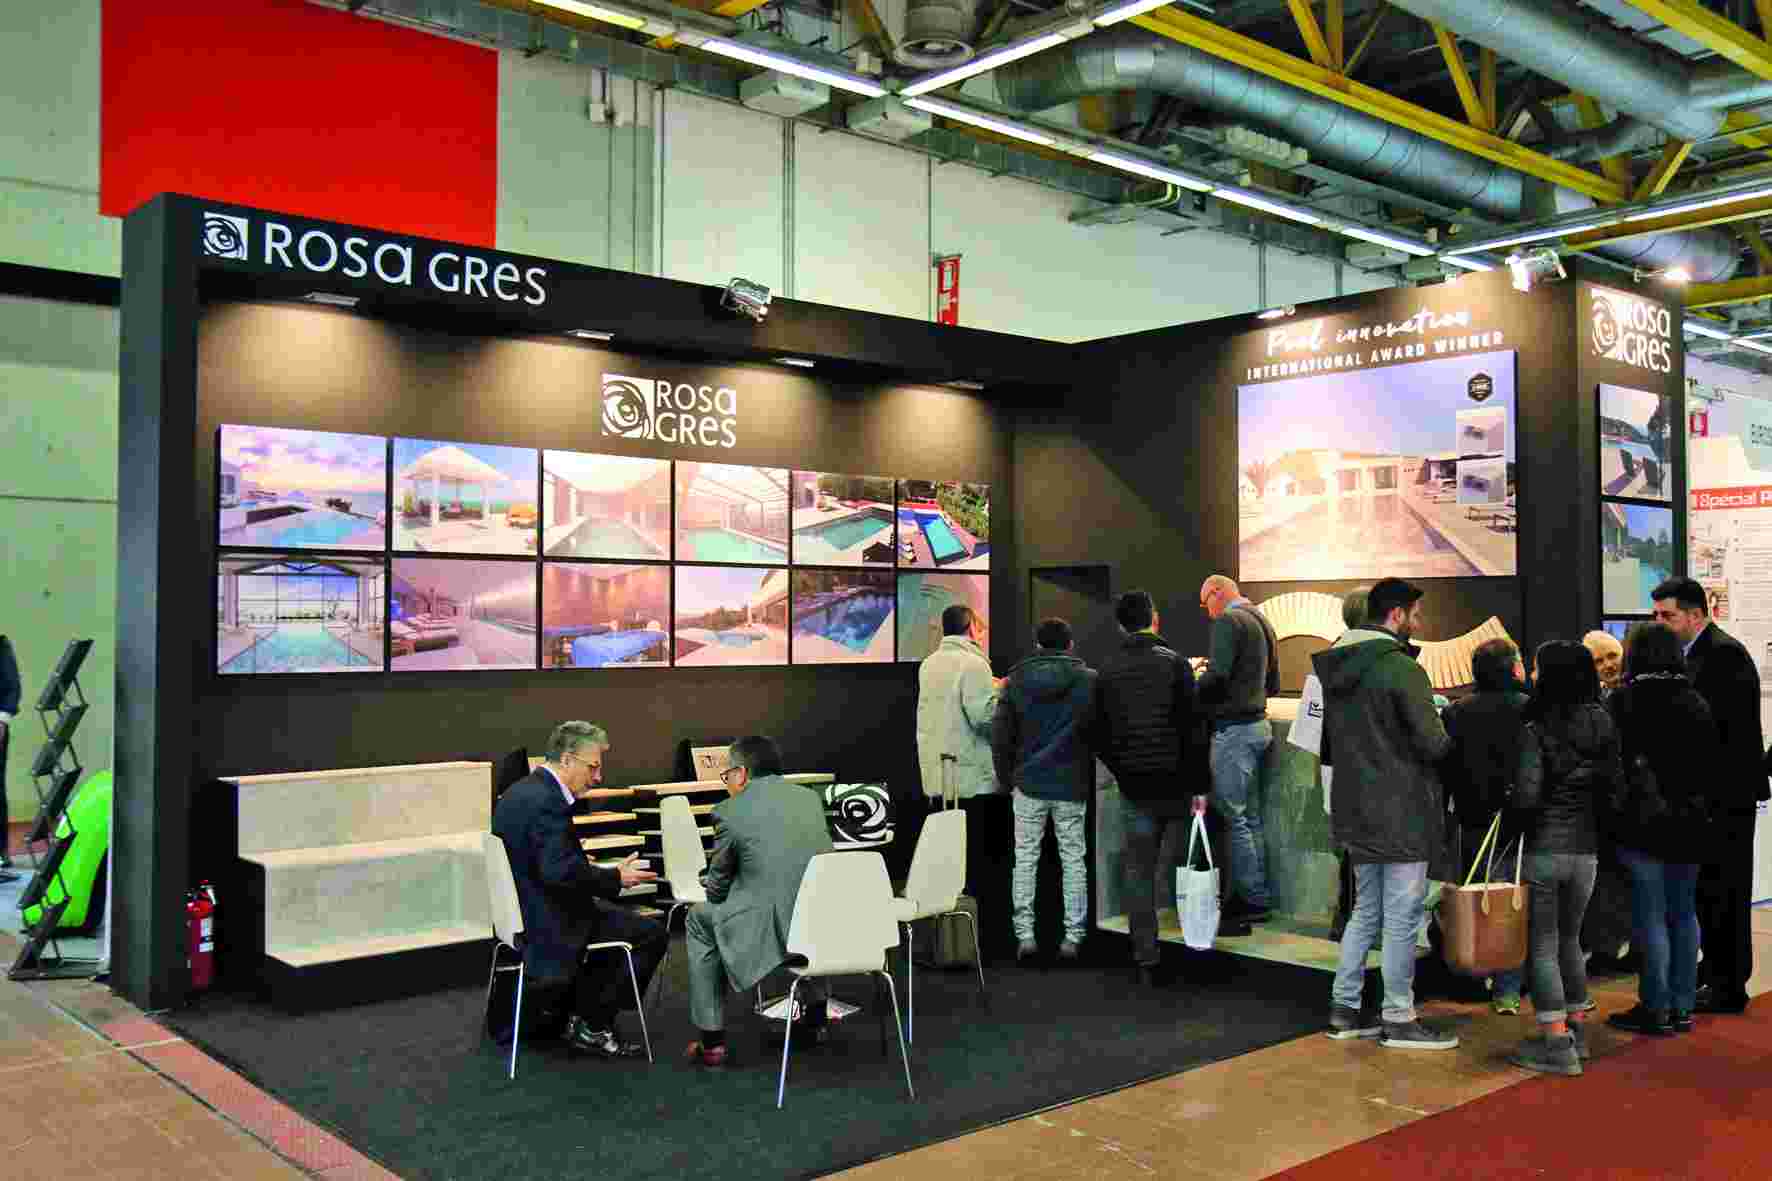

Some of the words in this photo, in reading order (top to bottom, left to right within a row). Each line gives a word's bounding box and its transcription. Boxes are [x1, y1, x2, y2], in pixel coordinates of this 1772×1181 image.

[1247, 353, 1363, 381] INTERNATIONAL
[1370, 343, 1426, 363] AWARD
[1434, 331, 1504, 353] WINNER
[1699, 491, 1757, 511] Special
